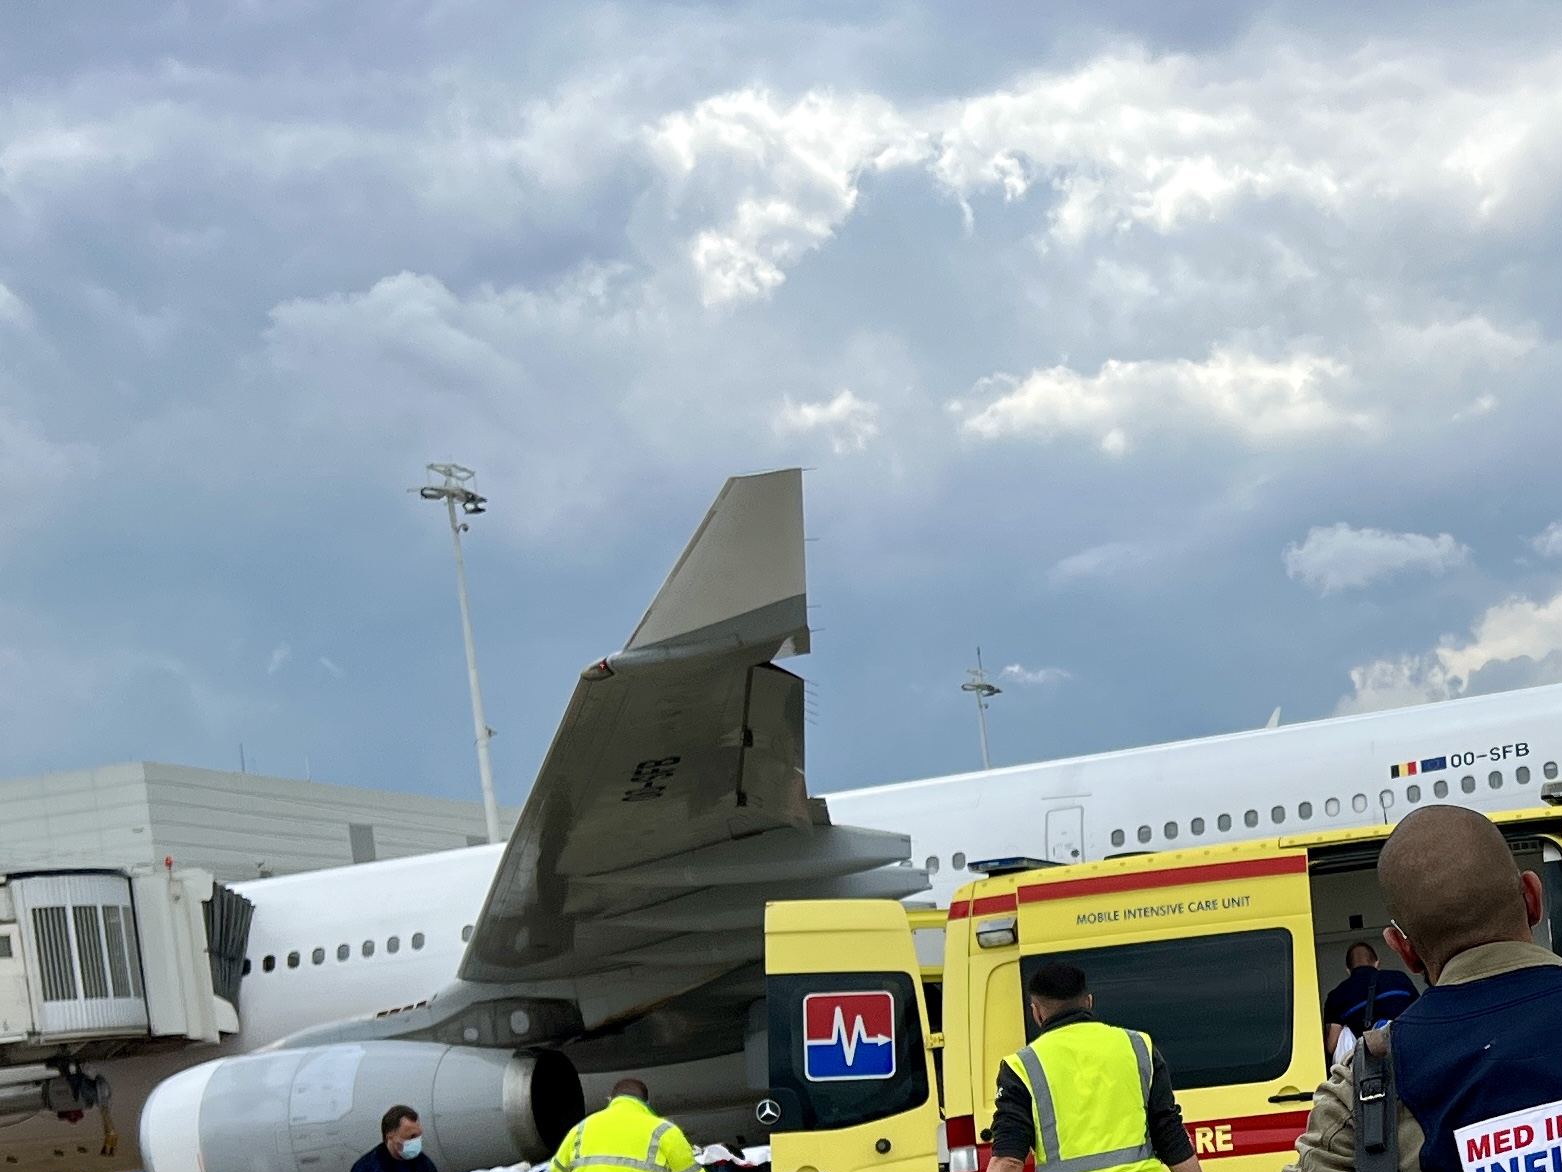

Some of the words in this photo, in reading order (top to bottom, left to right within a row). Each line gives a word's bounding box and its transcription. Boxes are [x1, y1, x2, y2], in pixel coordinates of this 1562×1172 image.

[1076, 910, 1119, 925] MOBILE
[1123, 902, 1185, 920] INTENSIVE
[1187, 898, 1218, 914] CARE
[1222, 895, 1251, 910] UNIT
[1189, 1124, 1234, 1154] RE
[1466, 1124, 1535, 1163] MED
